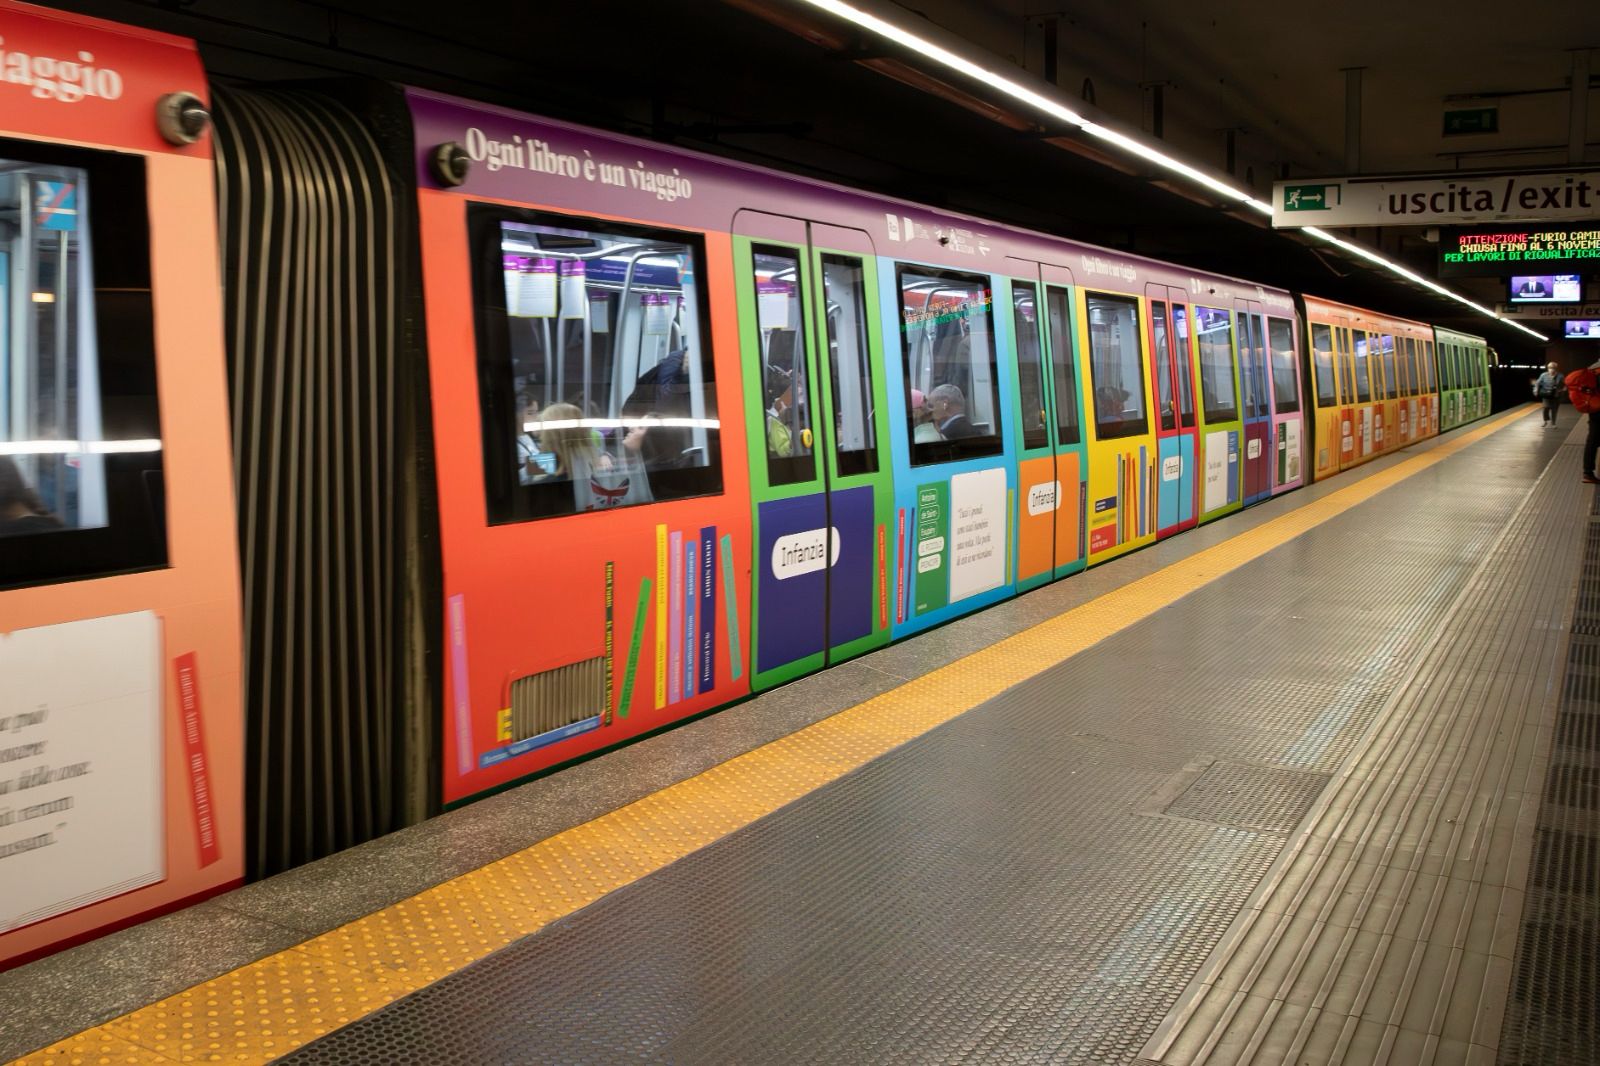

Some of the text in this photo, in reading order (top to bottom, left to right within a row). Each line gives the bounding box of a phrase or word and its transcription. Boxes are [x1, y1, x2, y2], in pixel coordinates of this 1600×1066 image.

[0, 35, 123, 103] aggio
[465, 127, 692, 202] Ogni libro è un viaggio
[1389, 178, 1591, 215] uscita/exit
[1445, 253, 1464, 262] PER
[1467, 252, 1505, 262] LAVORI
[1508, 251, 1521, 261] DI
[1459, 243, 1497, 254] CHIUSA
[1500, 242, 1527, 252] FINO
[1530, 242, 1544, 251] AL
[1547, 241, 1554, 250] 6
[782, 538, 824, 567] Infanzia
